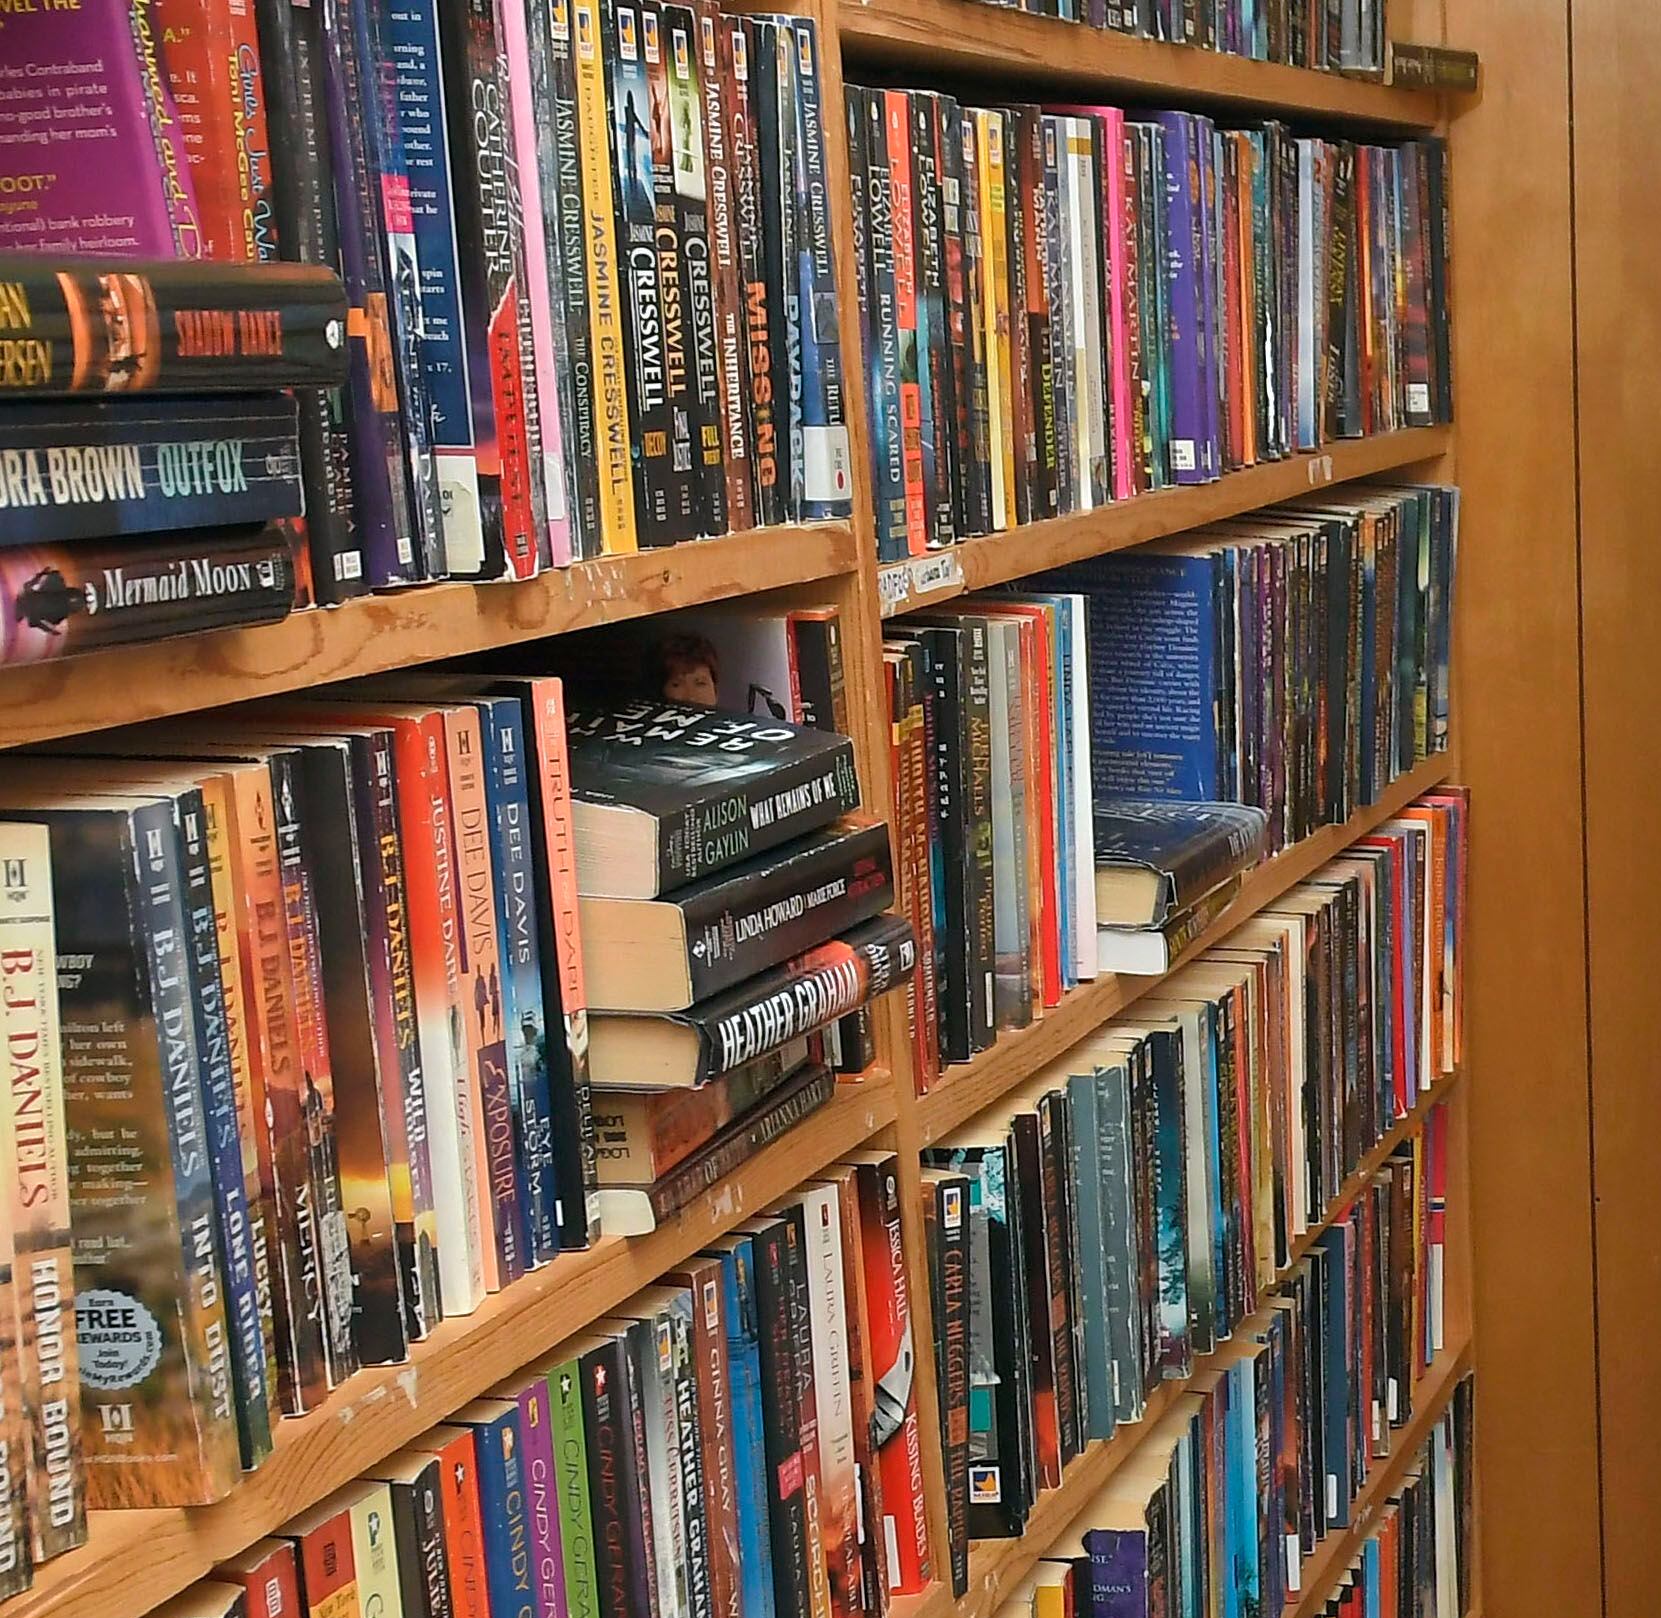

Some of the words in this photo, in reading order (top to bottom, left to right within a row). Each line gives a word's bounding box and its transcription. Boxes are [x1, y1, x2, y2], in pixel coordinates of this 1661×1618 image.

[471, 78, 501, 279] COULTER
[485, 83, 513, 273] CATHERINE
[869, 165, 884, 275] LOWELL
[925, 157, 940, 287] ELIZABETH
[890, 158, 906, 318] LOWELL
[630, 248, 663, 411] CRESSWELL
[655, 228, 686, 398] CRESSWELL
[685, 238, 716, 405] CRESSWELL
[880, 294, 897, 396] RUNNING
[886, 404, 902, 483] SCARED
[1041, 363, 1056, 470] DEFENDER
[52, 444, 145, 501] BROWN
[157, 440, 248, 497] OUTFOX
[104, 572, 188, 610] Mermaid
[193, 556, 252, 595] Moon
[703, 797, 748, 833] ALISON
[704, 828, 750, 865] GAYLIN
[749, 796, 776, 830] WHAT
[776, 781, 811, 821] REMAINS
[811, 778, 822, 803] OF
[823, 771, 836, 798] ME
[1, 949, 38, 1018] B.J.
[718, 995, 791, 1069] HEATHER
[792, 960, 859, 1034] GRAHAM
[7, 1032, 49, 1210] DANIELS
[884, 1218, 907, 1273] JESSICA
[944, 1248, 964, 1320] CARLA
[31, 1258, 65, 1384] HONOR
[76, 1308, 137, 1330] FREE
[893, 1277, 910, 1321] HALL
[945, 1323, 965, 1408] NEGGERS
[43, 1401, 74, 1527] BOUND
[903, 1412, 924, 1490] KISSING
[505, 1490, 532, 1593] CINDY
[910, 1493, 929, 1557] BLADES
